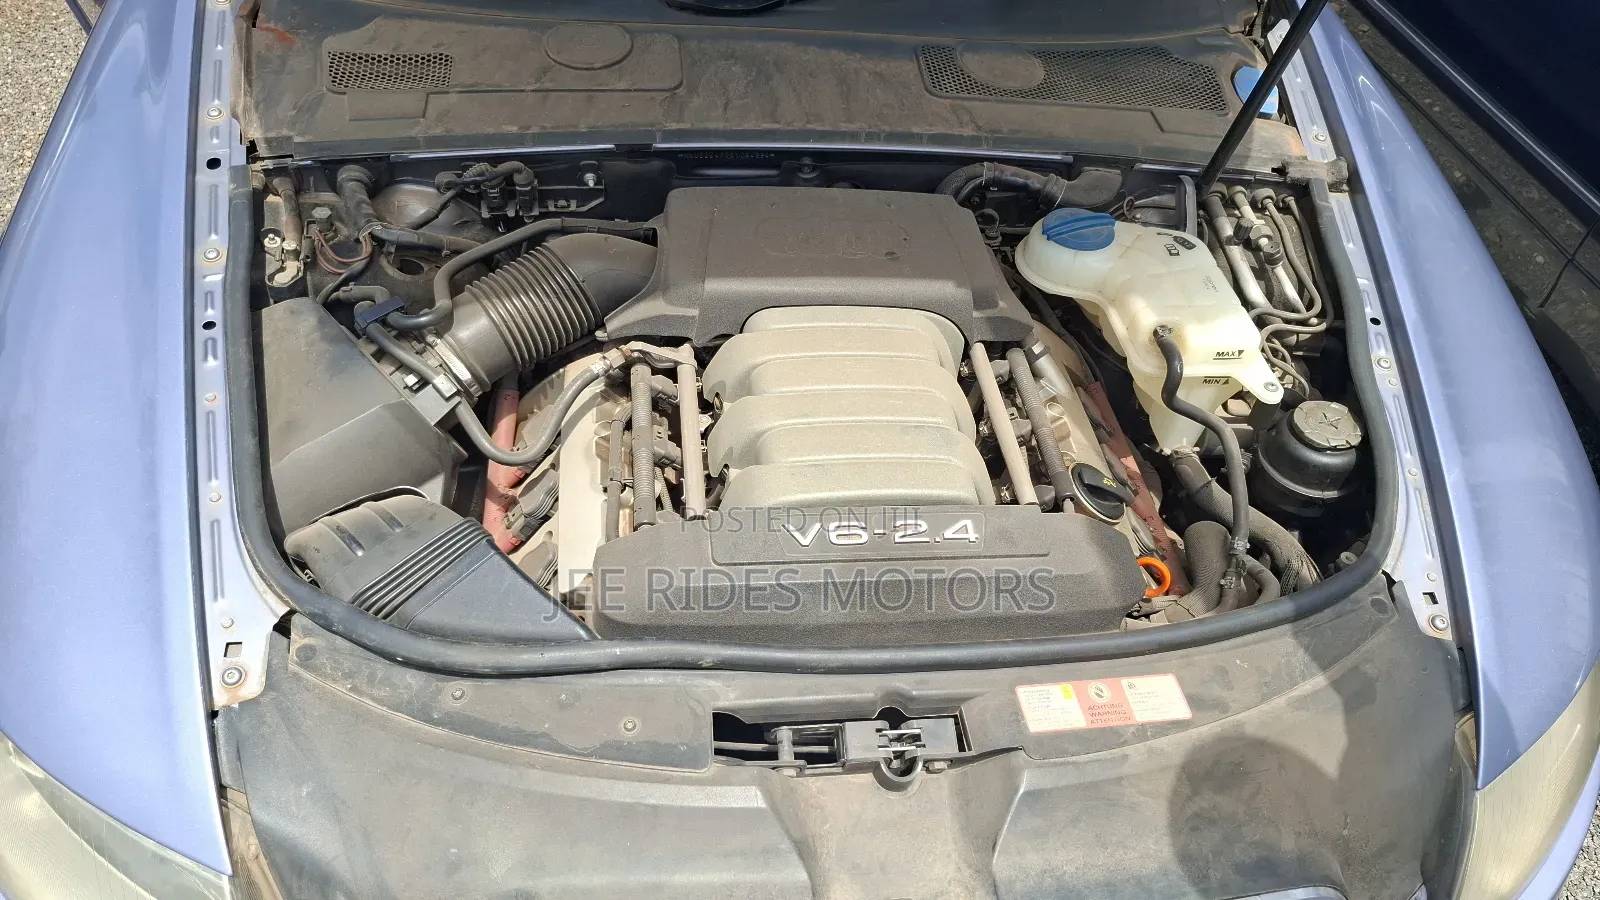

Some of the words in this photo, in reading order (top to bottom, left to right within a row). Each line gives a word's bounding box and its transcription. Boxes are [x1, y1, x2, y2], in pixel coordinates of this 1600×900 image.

[781, 519, 980, 548] V6-2.4
[1087, 702, 1124, 711] ACHTUNG
[1089, 709, 1127, 718] WARNING
[1090, 716, 1131, 725] ATTENTION
